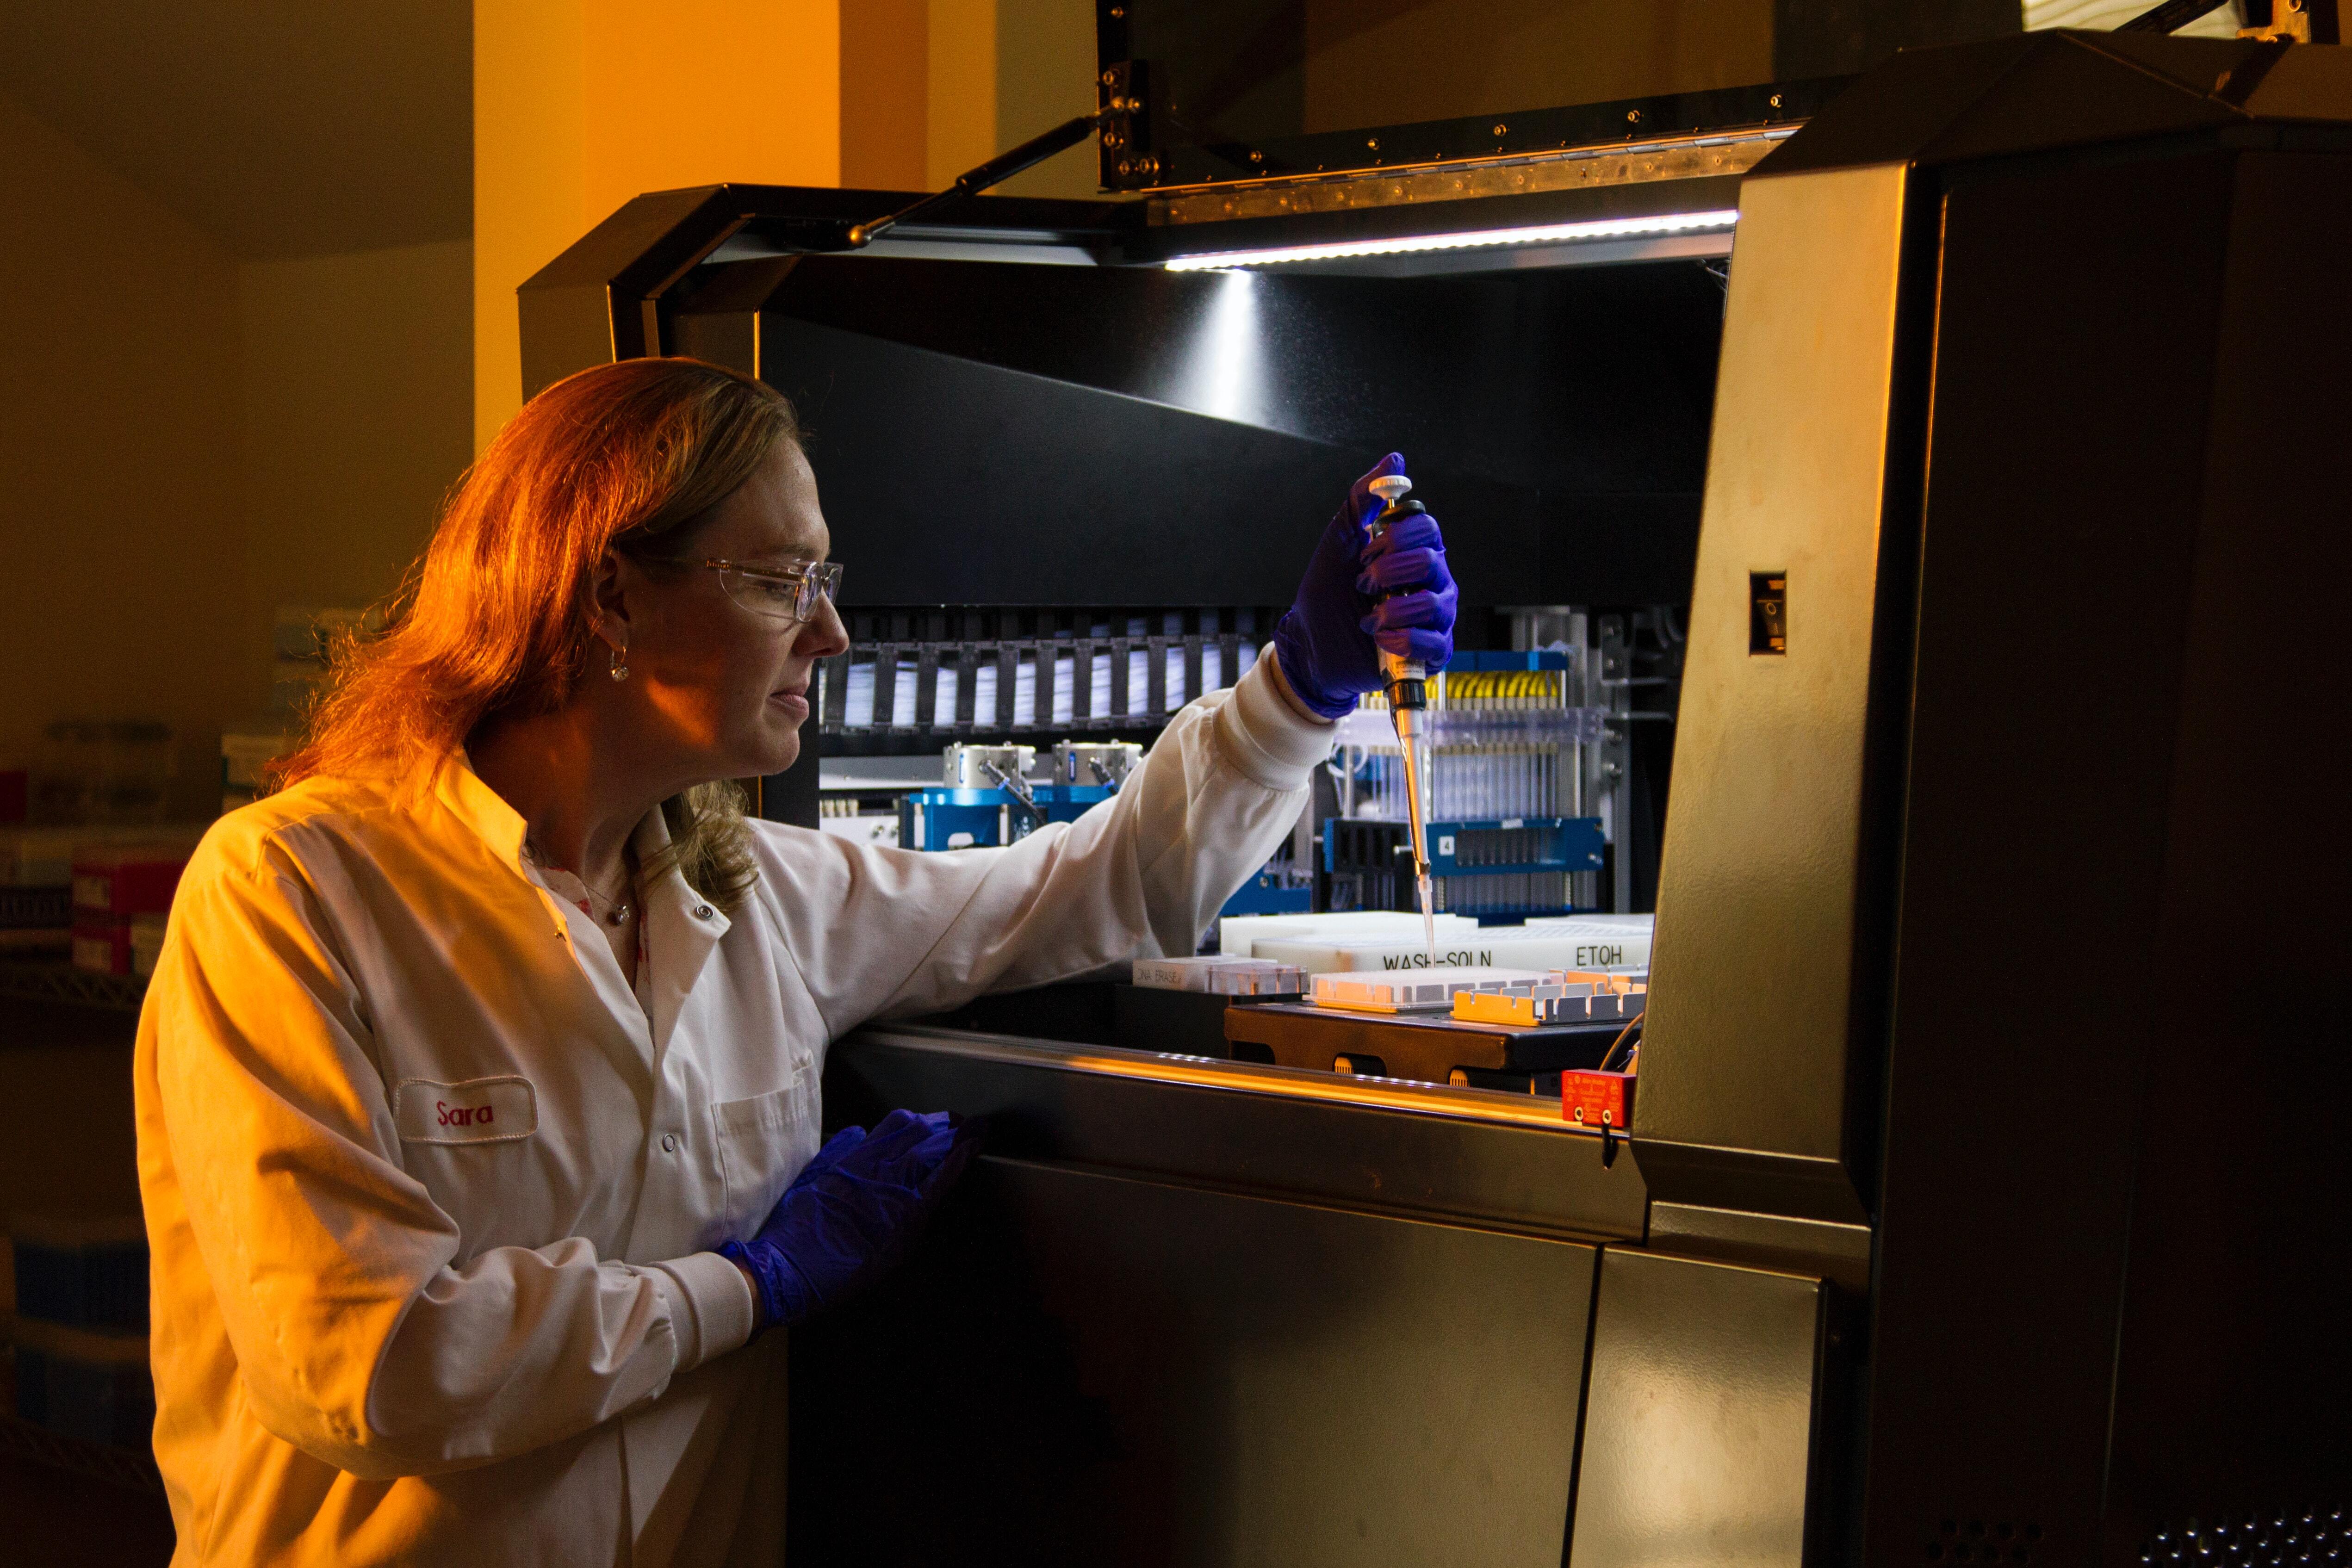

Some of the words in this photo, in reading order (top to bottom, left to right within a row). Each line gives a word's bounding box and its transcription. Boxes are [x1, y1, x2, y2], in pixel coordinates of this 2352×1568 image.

[1383, 950, 1491, 970] WASH-SOLN
[1577, 945, 1621, 966] ETOH
[436, 1100, 494, 1126] Sara
